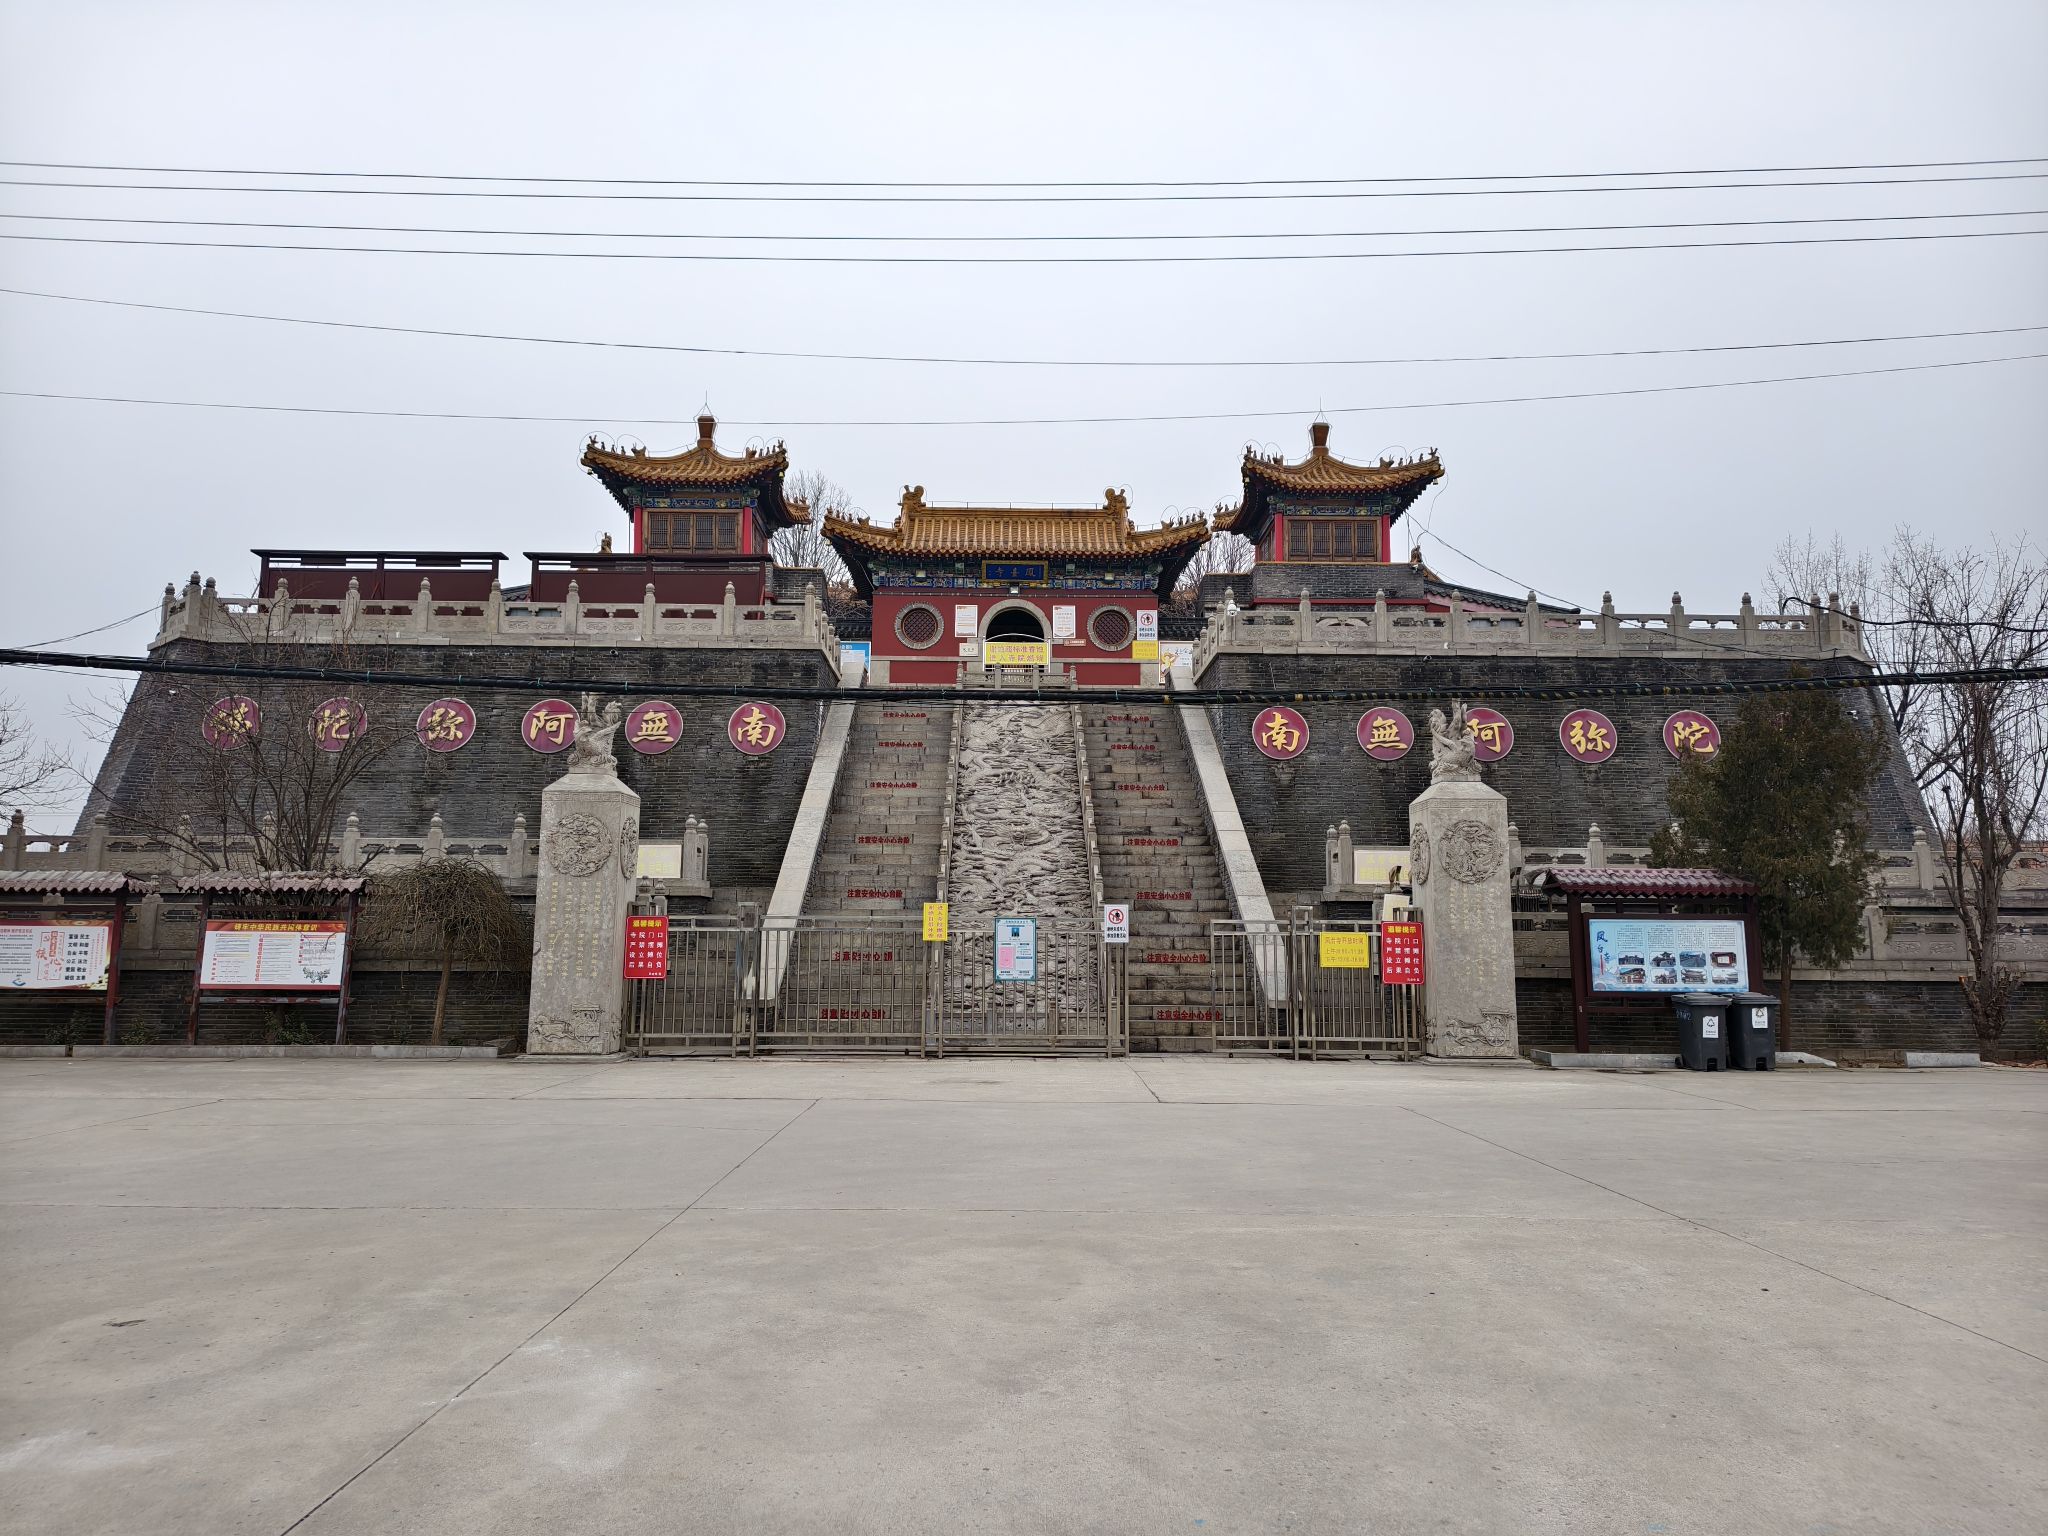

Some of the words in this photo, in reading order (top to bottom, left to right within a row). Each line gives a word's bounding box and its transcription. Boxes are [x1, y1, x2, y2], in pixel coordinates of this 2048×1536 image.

[529, 709, 574, 745] 阿
[631, 710, 674, 743] 無
[736, 706, 777, 747] 南
[1260, 709, 1303, 754] 南
[1366, 714, 1410, 752] 無
[1569, 719, 1612, 755] 弥
[1672, 720, 1714, 754] 陀
[858, 836, 909, 844] 注意安全小心台阶
[1128, 838, 1179, 847] 注意安全小心台阶
[848, 890, 903, 899] 注意安全小心台阶
[1136, 892, 1192, 900] 注意安全小心台阶
[1147, 953, 1207, 963] 注意安全小心台阶
